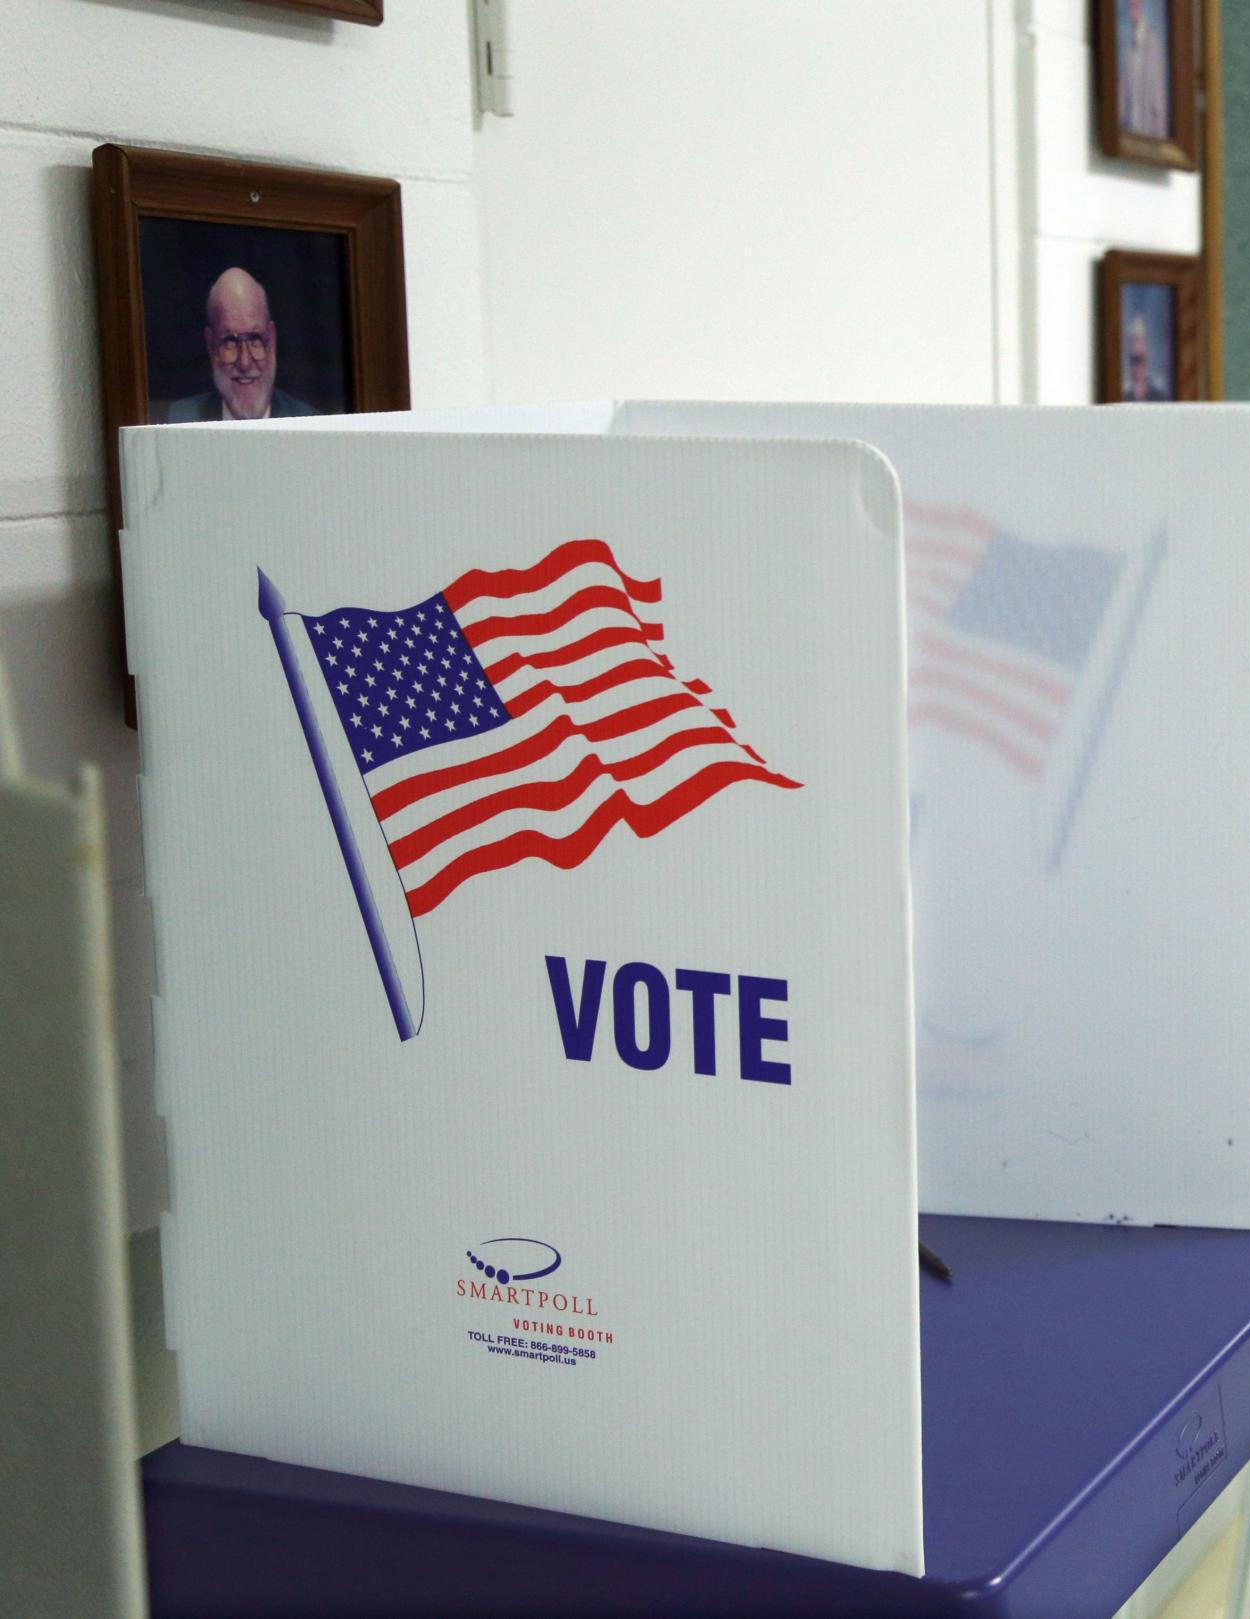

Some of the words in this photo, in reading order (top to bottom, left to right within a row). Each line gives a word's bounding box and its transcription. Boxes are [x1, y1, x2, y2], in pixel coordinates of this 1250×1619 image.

[545, 955, 792, 1085] VOTE
[457, 1280, 598, 1315] SMARTPOLL
[467, 1330, 494, 1344] TOLL
[497, 1336, 528, 1349] FREE:
[530, 1341, 596, 1359] 866-899-5858
[513, 1318, 563, 1336] VOTING
[568, 1327, 613, 1344] BOOTH
[488, 1345, 577, 1365] www.smartpoll.us
